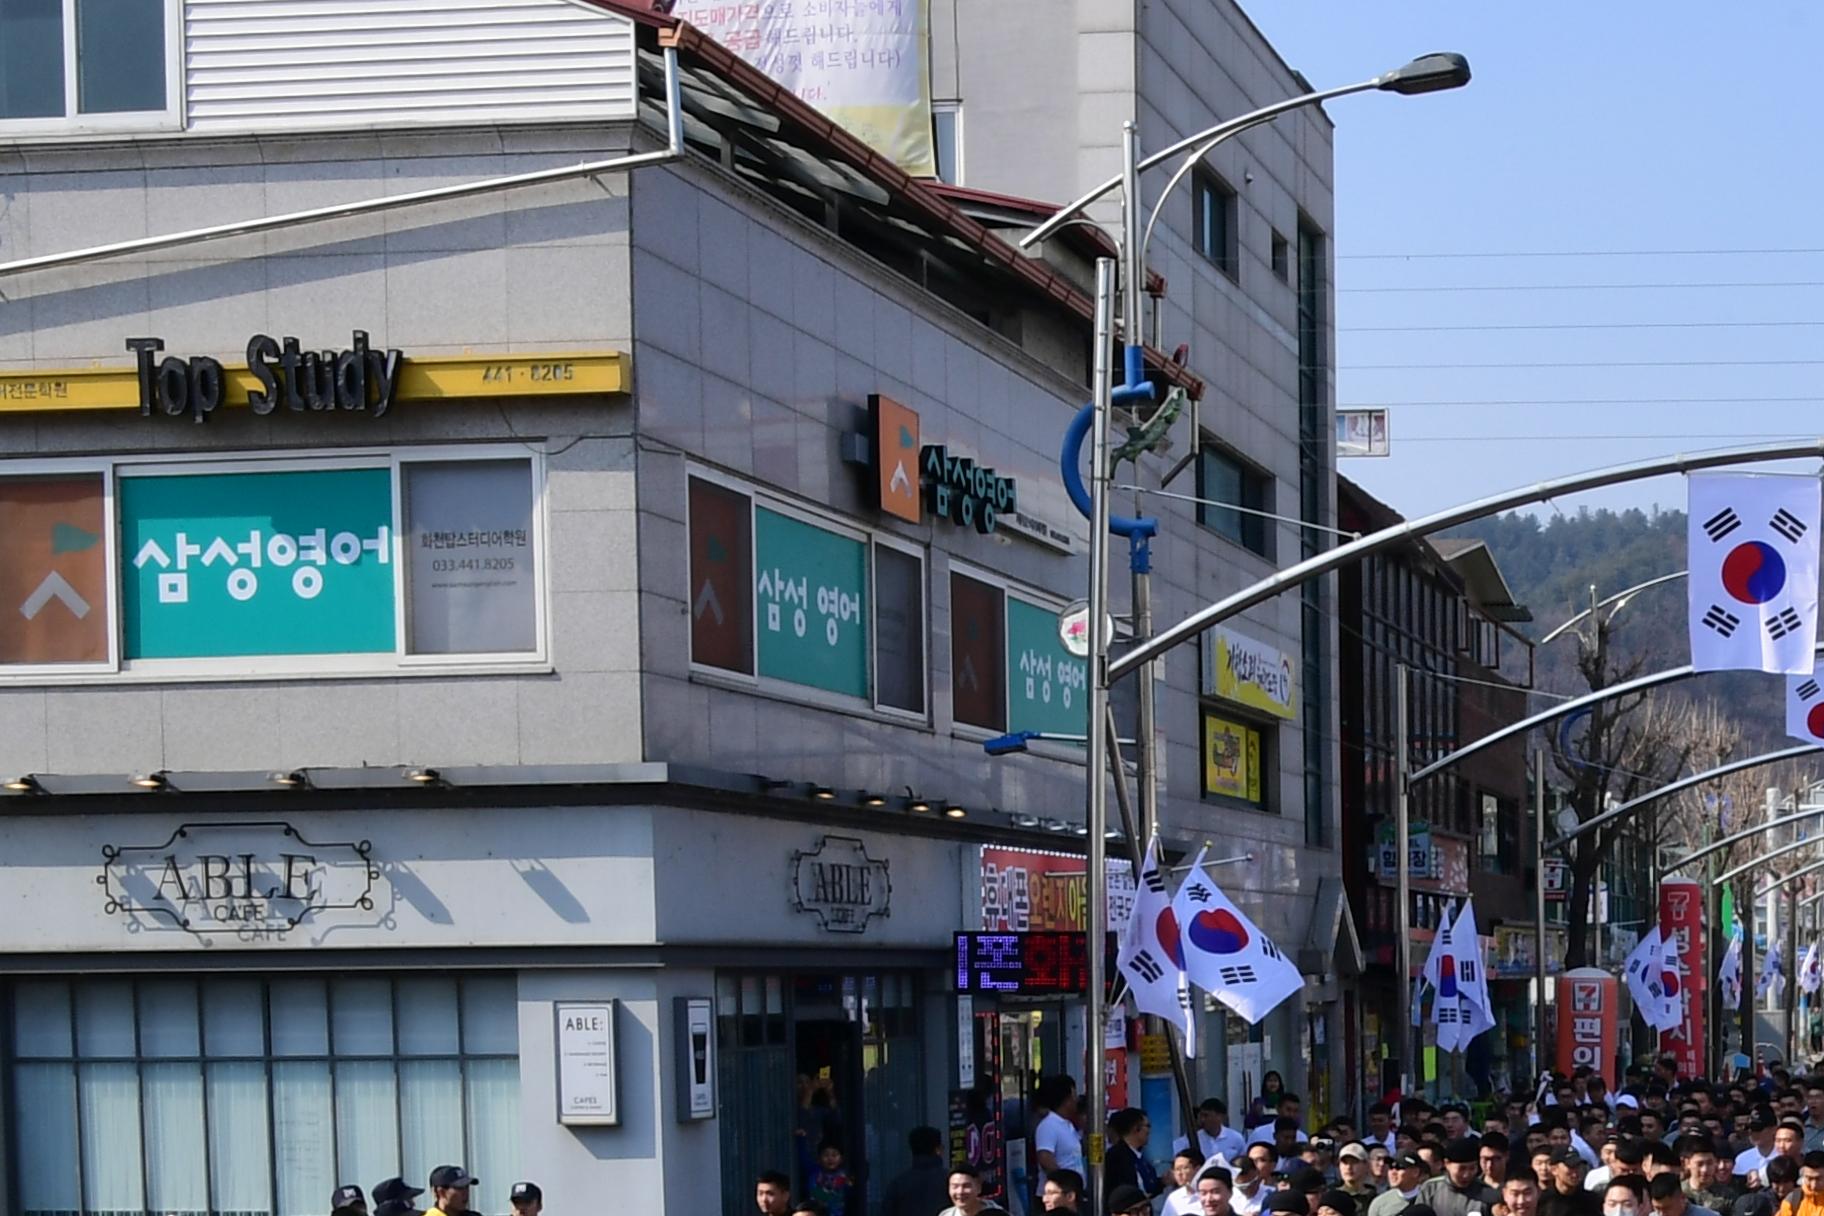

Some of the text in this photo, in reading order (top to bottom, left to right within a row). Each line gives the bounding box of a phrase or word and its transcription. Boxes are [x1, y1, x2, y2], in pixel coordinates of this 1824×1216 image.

[126, 330, 402, 423] Top Study
[918, 445, 1017, 534] 삼성영어
[134, 526, 390, 604] 삼성영어
[758, 568, 861, 647] 삼성 영어
[1019, 649, 1052, 703] 삼성
[151, 853, 318, 902] ABLE
[807, 862, 872, 906] ABLE
[213, 903, 265, 923] CAFE
